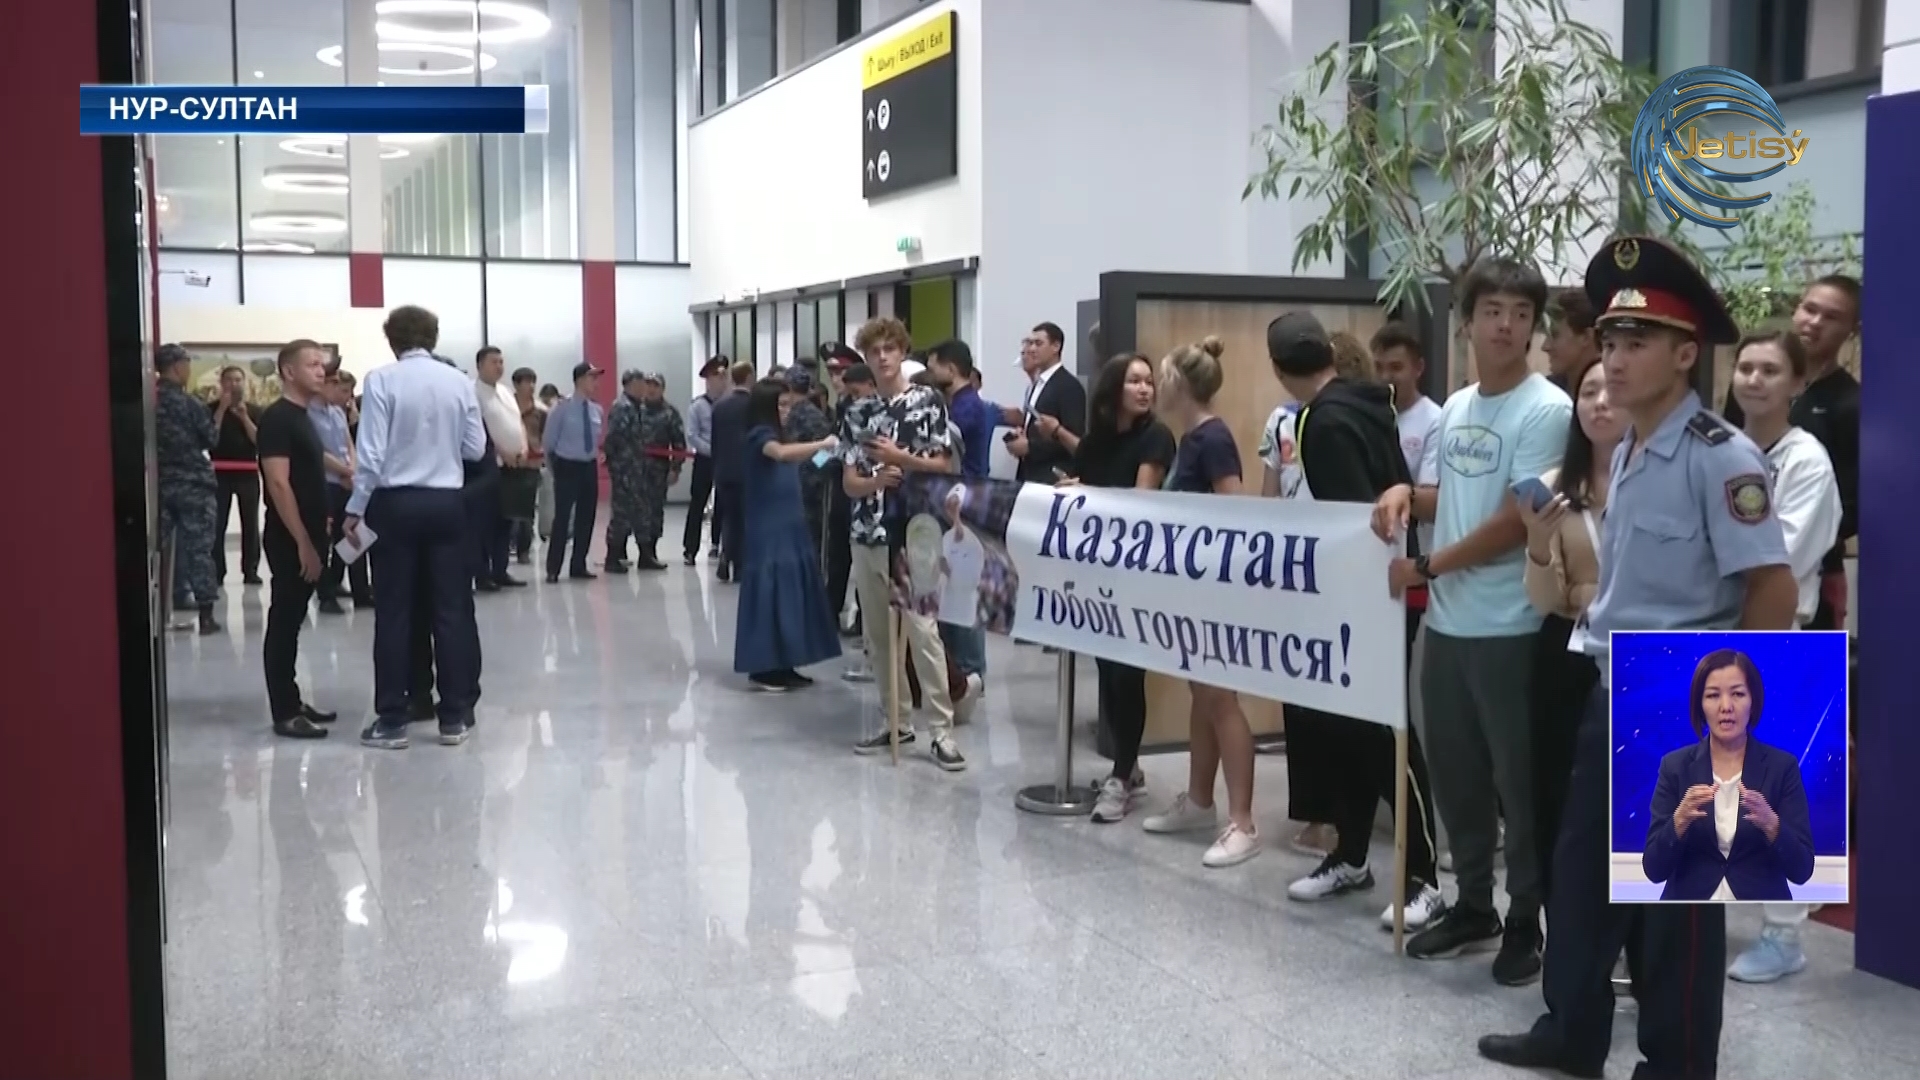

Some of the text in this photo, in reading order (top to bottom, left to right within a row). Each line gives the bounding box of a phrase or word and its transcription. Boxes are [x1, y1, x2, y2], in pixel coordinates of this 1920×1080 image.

[1037, 493, 1321, 594] Казахстан
[1032, 581, 1351, 687] тобой гордится!
